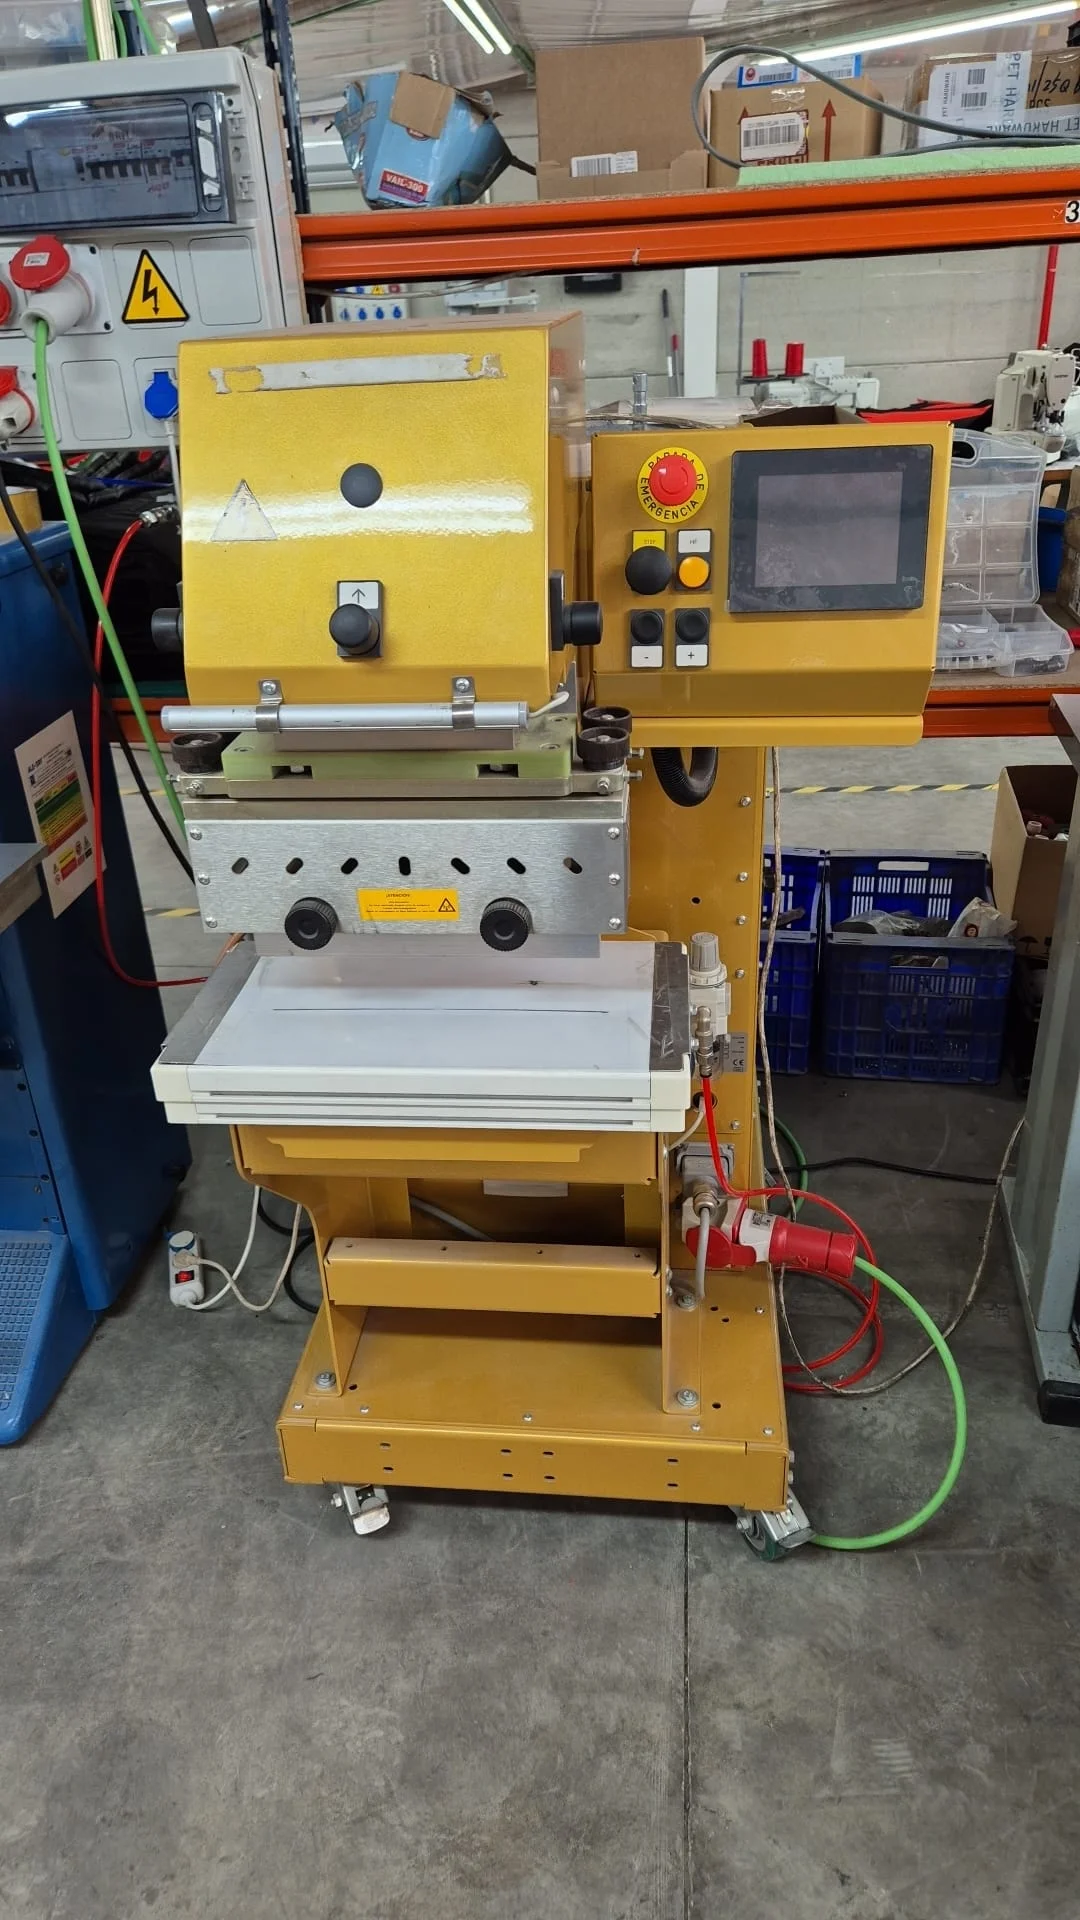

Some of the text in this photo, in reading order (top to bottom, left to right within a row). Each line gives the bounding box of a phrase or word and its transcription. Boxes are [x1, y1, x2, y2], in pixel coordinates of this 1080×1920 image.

[1006, 53, 1021, 80] PET
[1065, 200, 1080, 223] 3
[640, 477, 699, 520] EMERGENCIA
